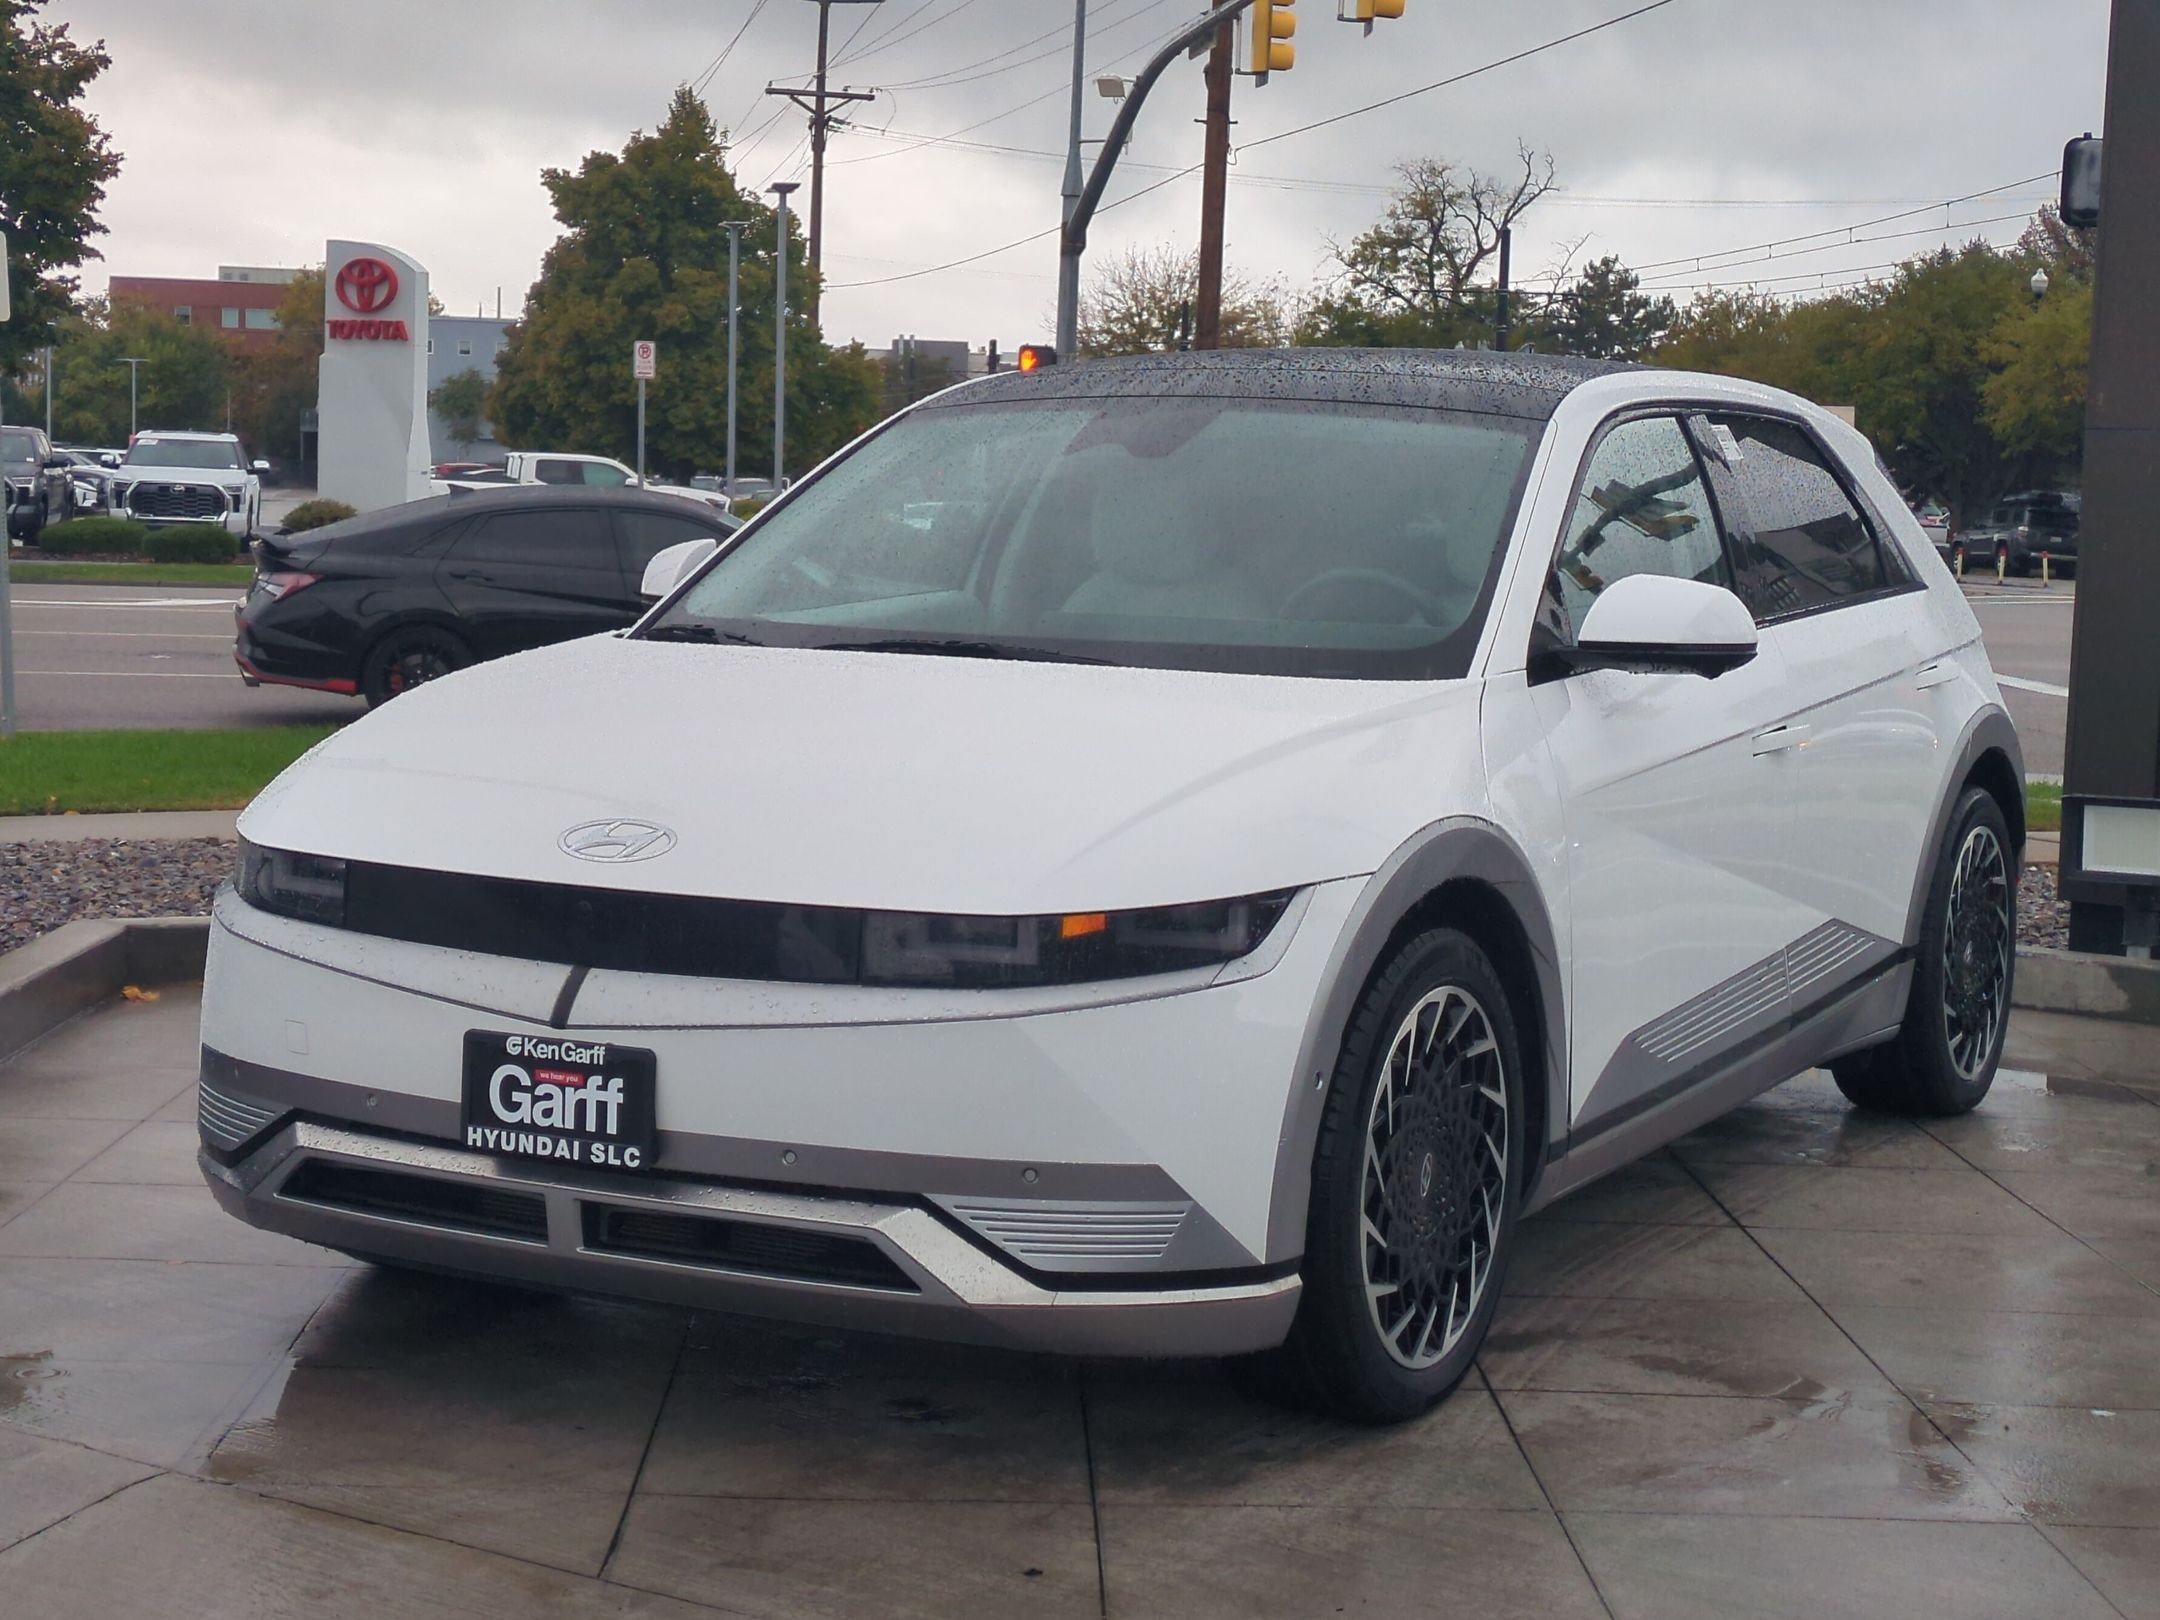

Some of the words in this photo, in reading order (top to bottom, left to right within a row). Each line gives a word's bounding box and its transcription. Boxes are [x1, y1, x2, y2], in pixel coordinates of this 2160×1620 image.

[326, 319, 408, 341] TOYOTA
[489, 1064, 624, 1135] Garff
[467, 1126, 580, 1161] HYUNDAI
[590, 1143, 641, 1168] SLC
